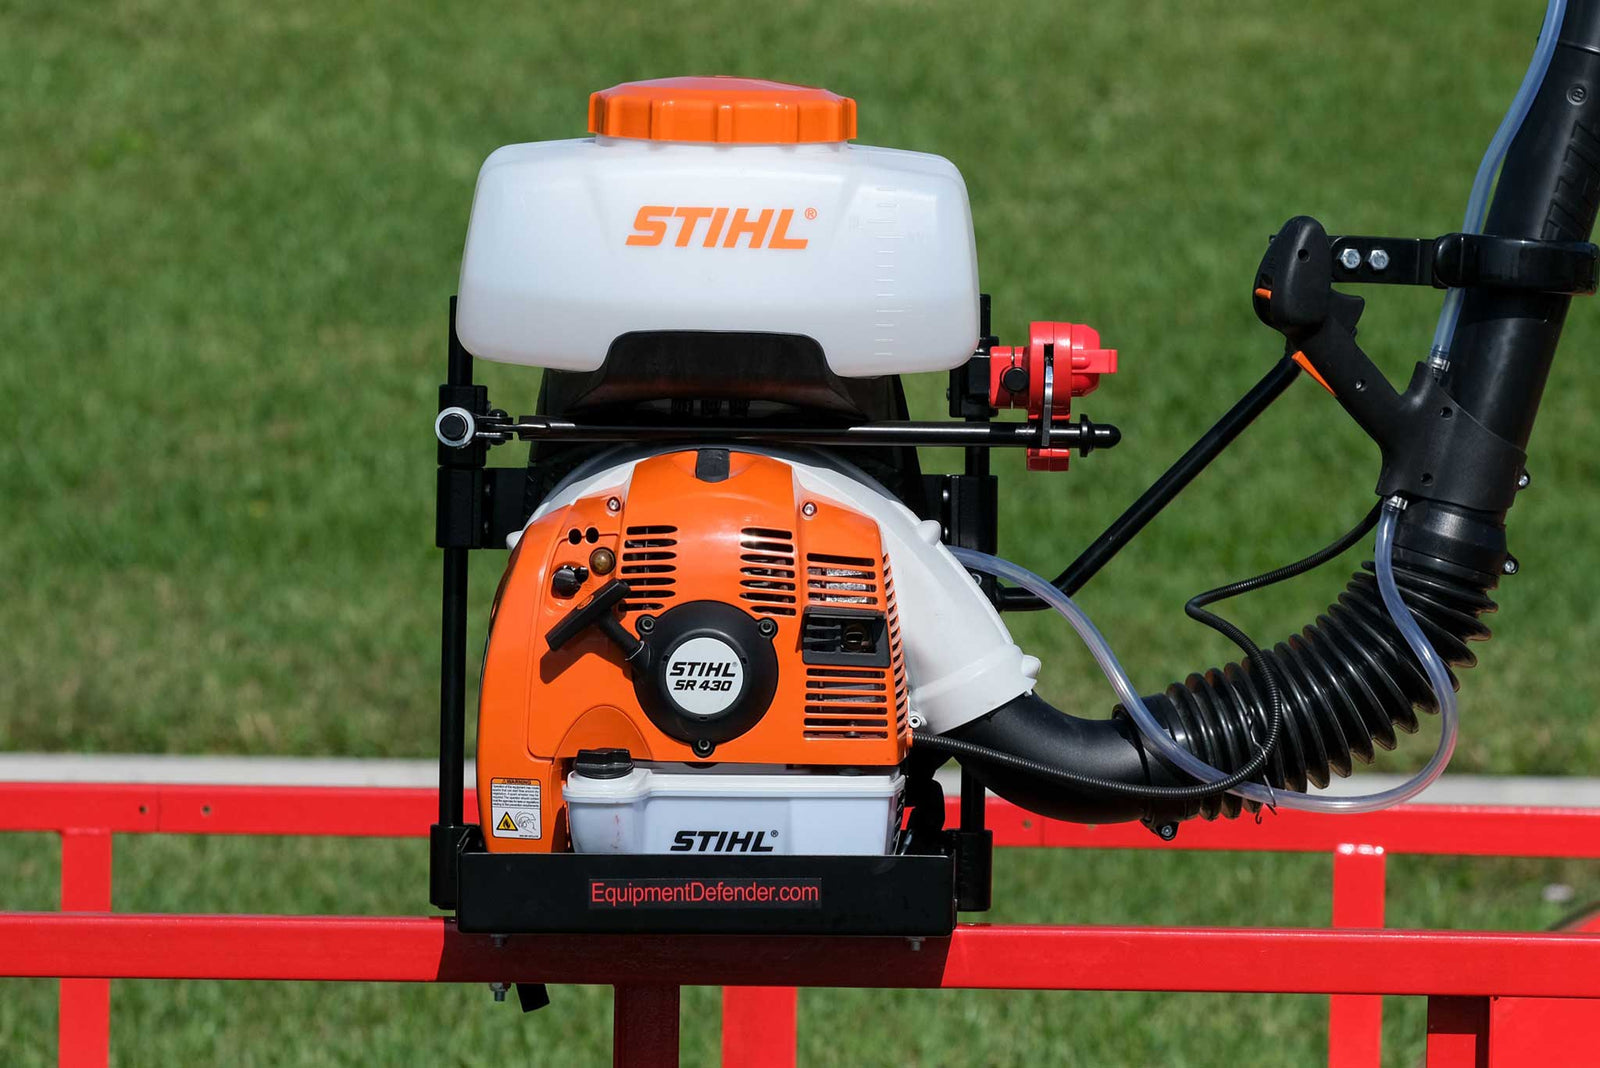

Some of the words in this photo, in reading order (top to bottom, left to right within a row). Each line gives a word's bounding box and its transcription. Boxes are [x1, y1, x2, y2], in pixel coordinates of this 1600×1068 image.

[669, 661, 736, 678] STIHL
[673, 679, 697, 691] SR
[698, 680, 733, 692] 430
[591, 881, 819, 907] EquipmentDefender.com
